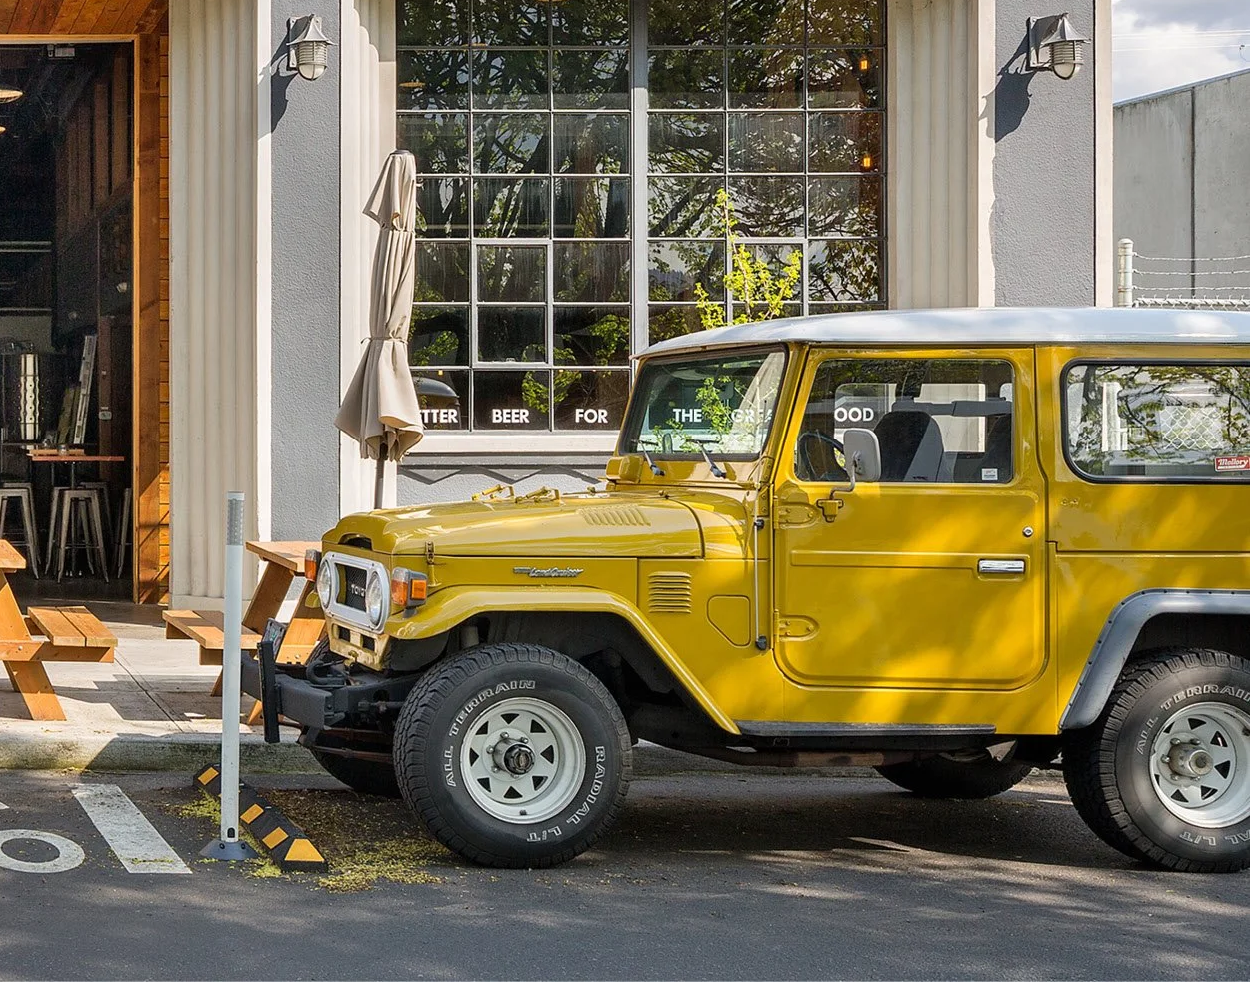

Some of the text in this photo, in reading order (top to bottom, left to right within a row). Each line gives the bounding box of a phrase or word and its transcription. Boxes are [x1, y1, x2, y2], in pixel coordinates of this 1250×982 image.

[419, 409, 459, 423] TTER
[492, 408, 530, 424] BEER
[575, 408, 608, 424] FOR
[673, 408, 702, 423] THE
[834, 407, 874, 423] OOD
[443, 679, 536, 787] ALL TERRAIN
[1136, 716, 1159, 755] ALL
[526, 745, 606, 842] RADIAL L/T
